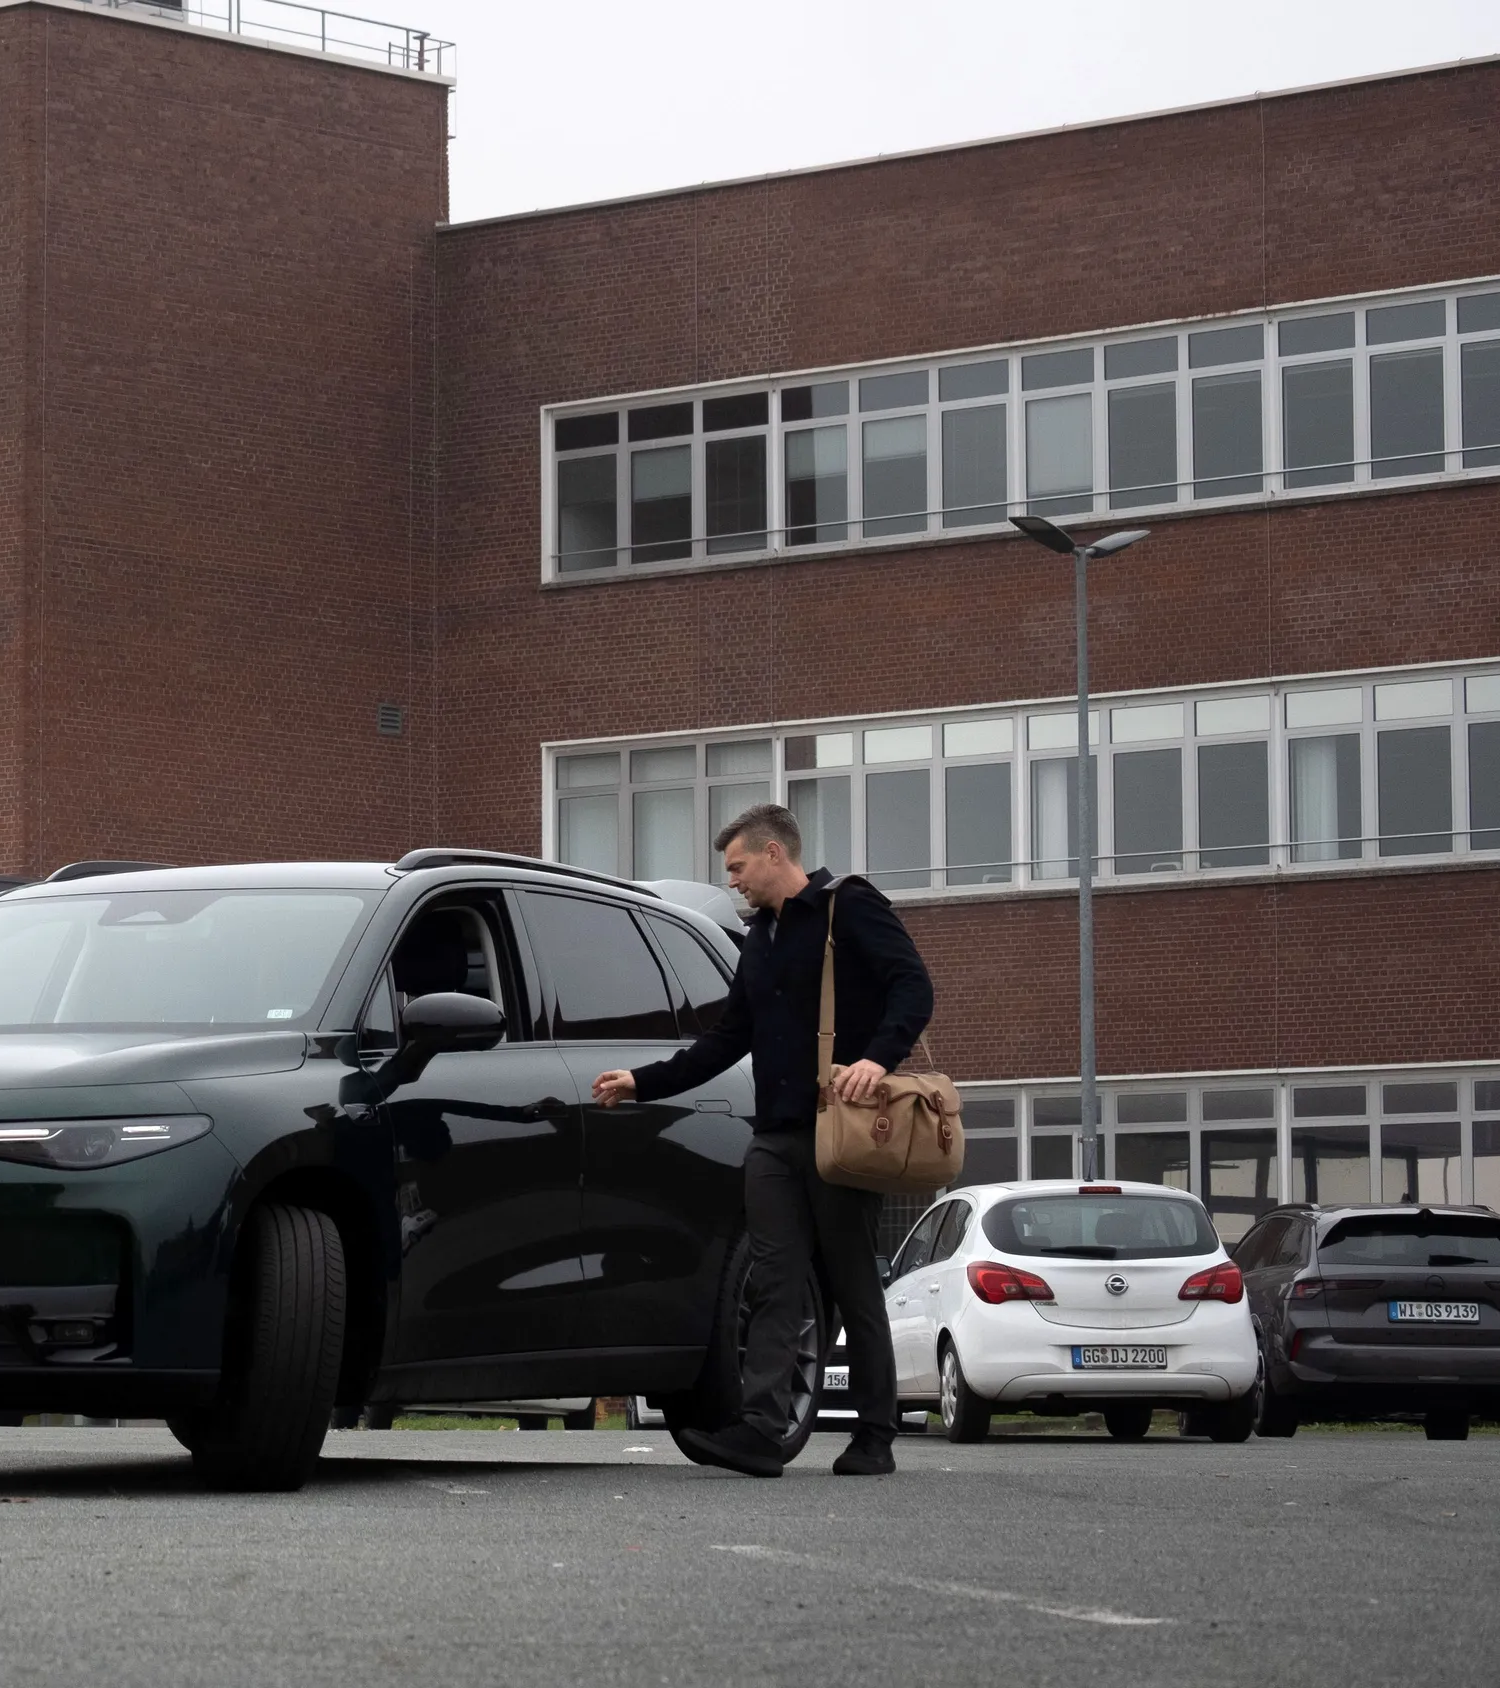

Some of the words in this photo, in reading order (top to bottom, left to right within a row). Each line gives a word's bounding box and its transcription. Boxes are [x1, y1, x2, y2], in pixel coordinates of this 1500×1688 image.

[1399, 1303, 1415, 1317] WI
[1425, 1303, 1442, 1318] OS
[1444, 1304, 1477, 1319] 9139
[1083, 1348, 1100, 1364] GG
[1111, 1348, 1128, 1364] DJ
[1131, 1348, 1165, 1364] 2200
[827, 1374, 847, 1387] 156
